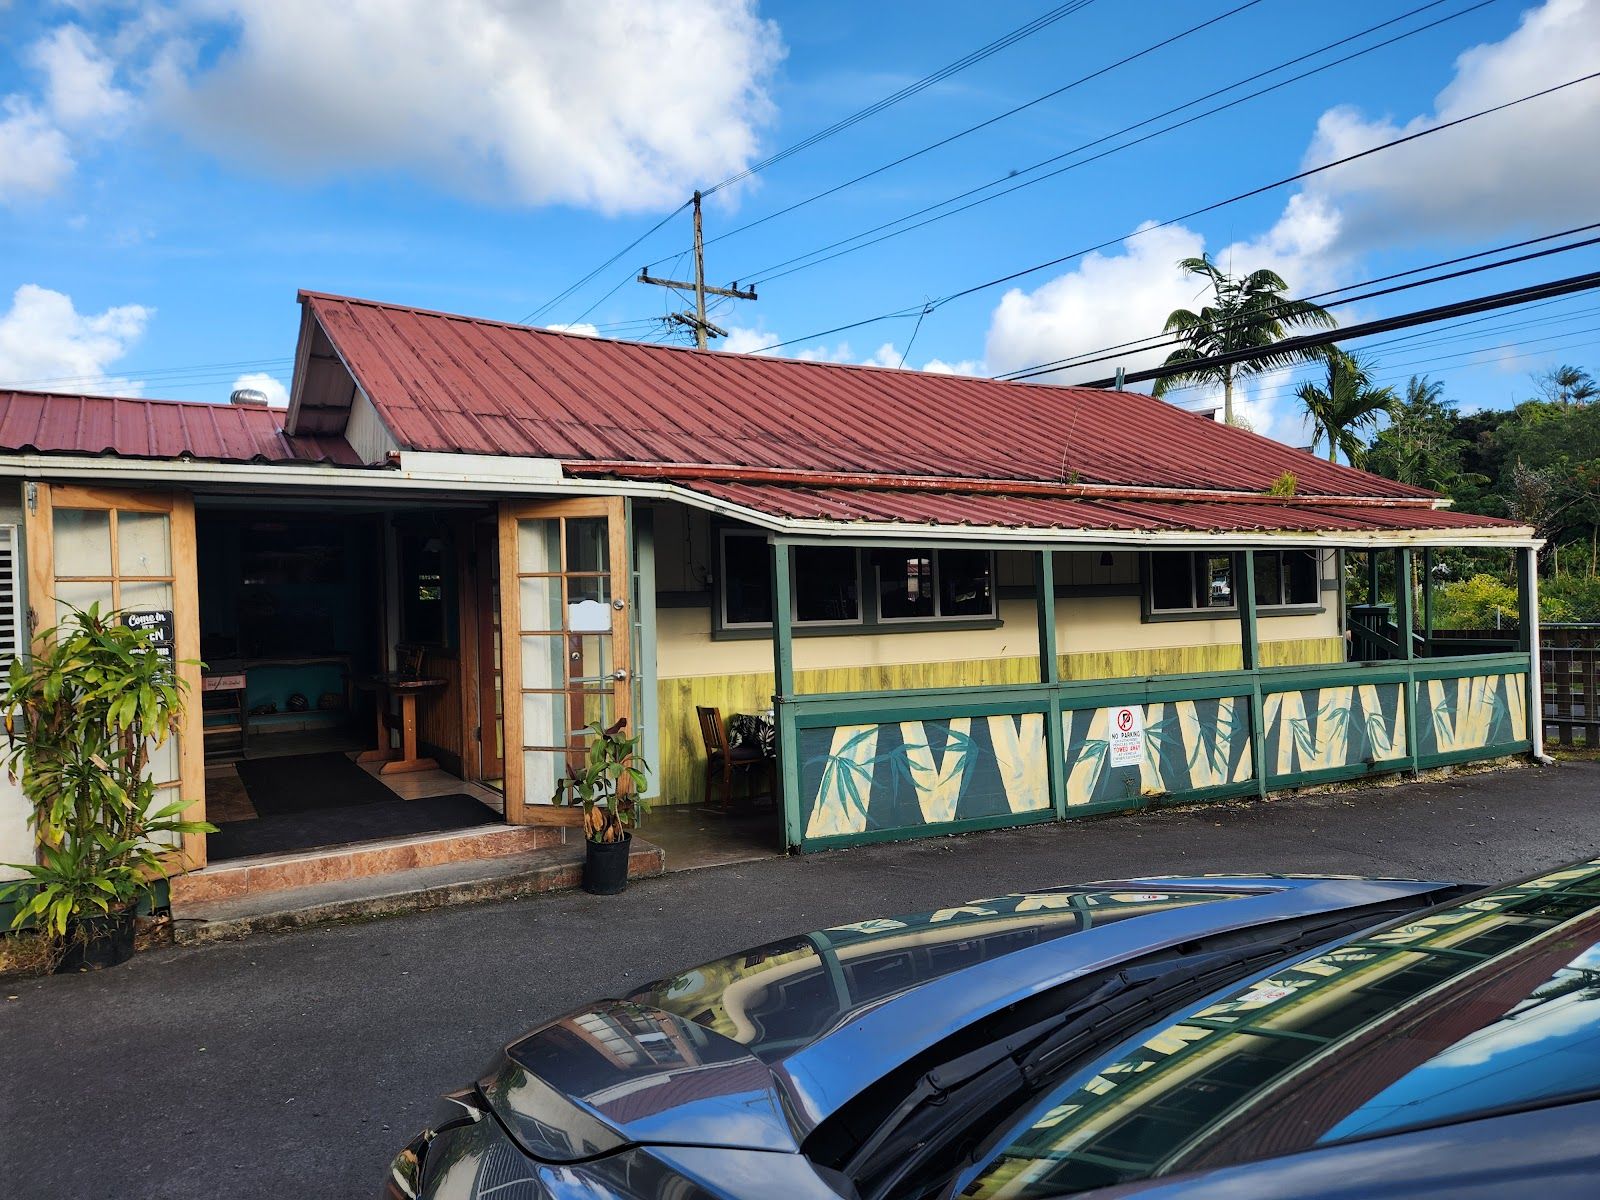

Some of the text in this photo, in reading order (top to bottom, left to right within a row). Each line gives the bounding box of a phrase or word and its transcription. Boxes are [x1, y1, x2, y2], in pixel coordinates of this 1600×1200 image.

[128, 614, 155, 627] Come
[155, 612, 167, 622] in
[1111, 730, 1141, 740] NO PARKING
